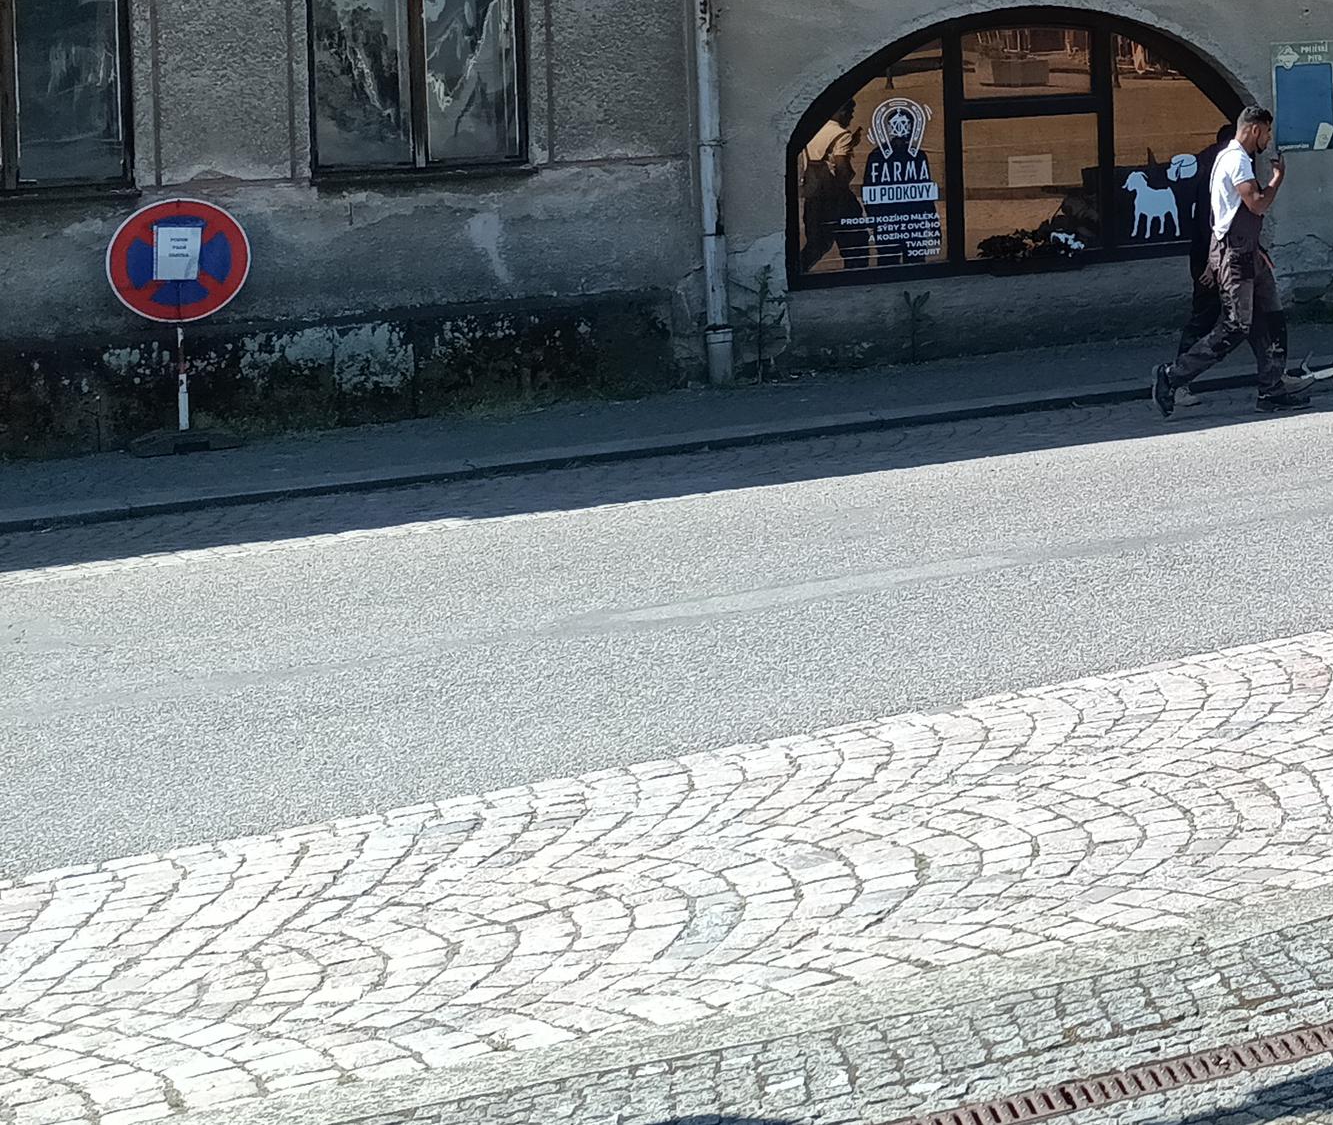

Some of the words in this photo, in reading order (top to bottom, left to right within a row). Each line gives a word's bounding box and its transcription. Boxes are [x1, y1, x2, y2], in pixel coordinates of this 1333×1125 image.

[871, 160, 929, 183] FARMA
[869, 188, 876, 202] U
[880, 185, 931, 201] PODKOVY
[841, 216, 874, 225] PRODEJ
